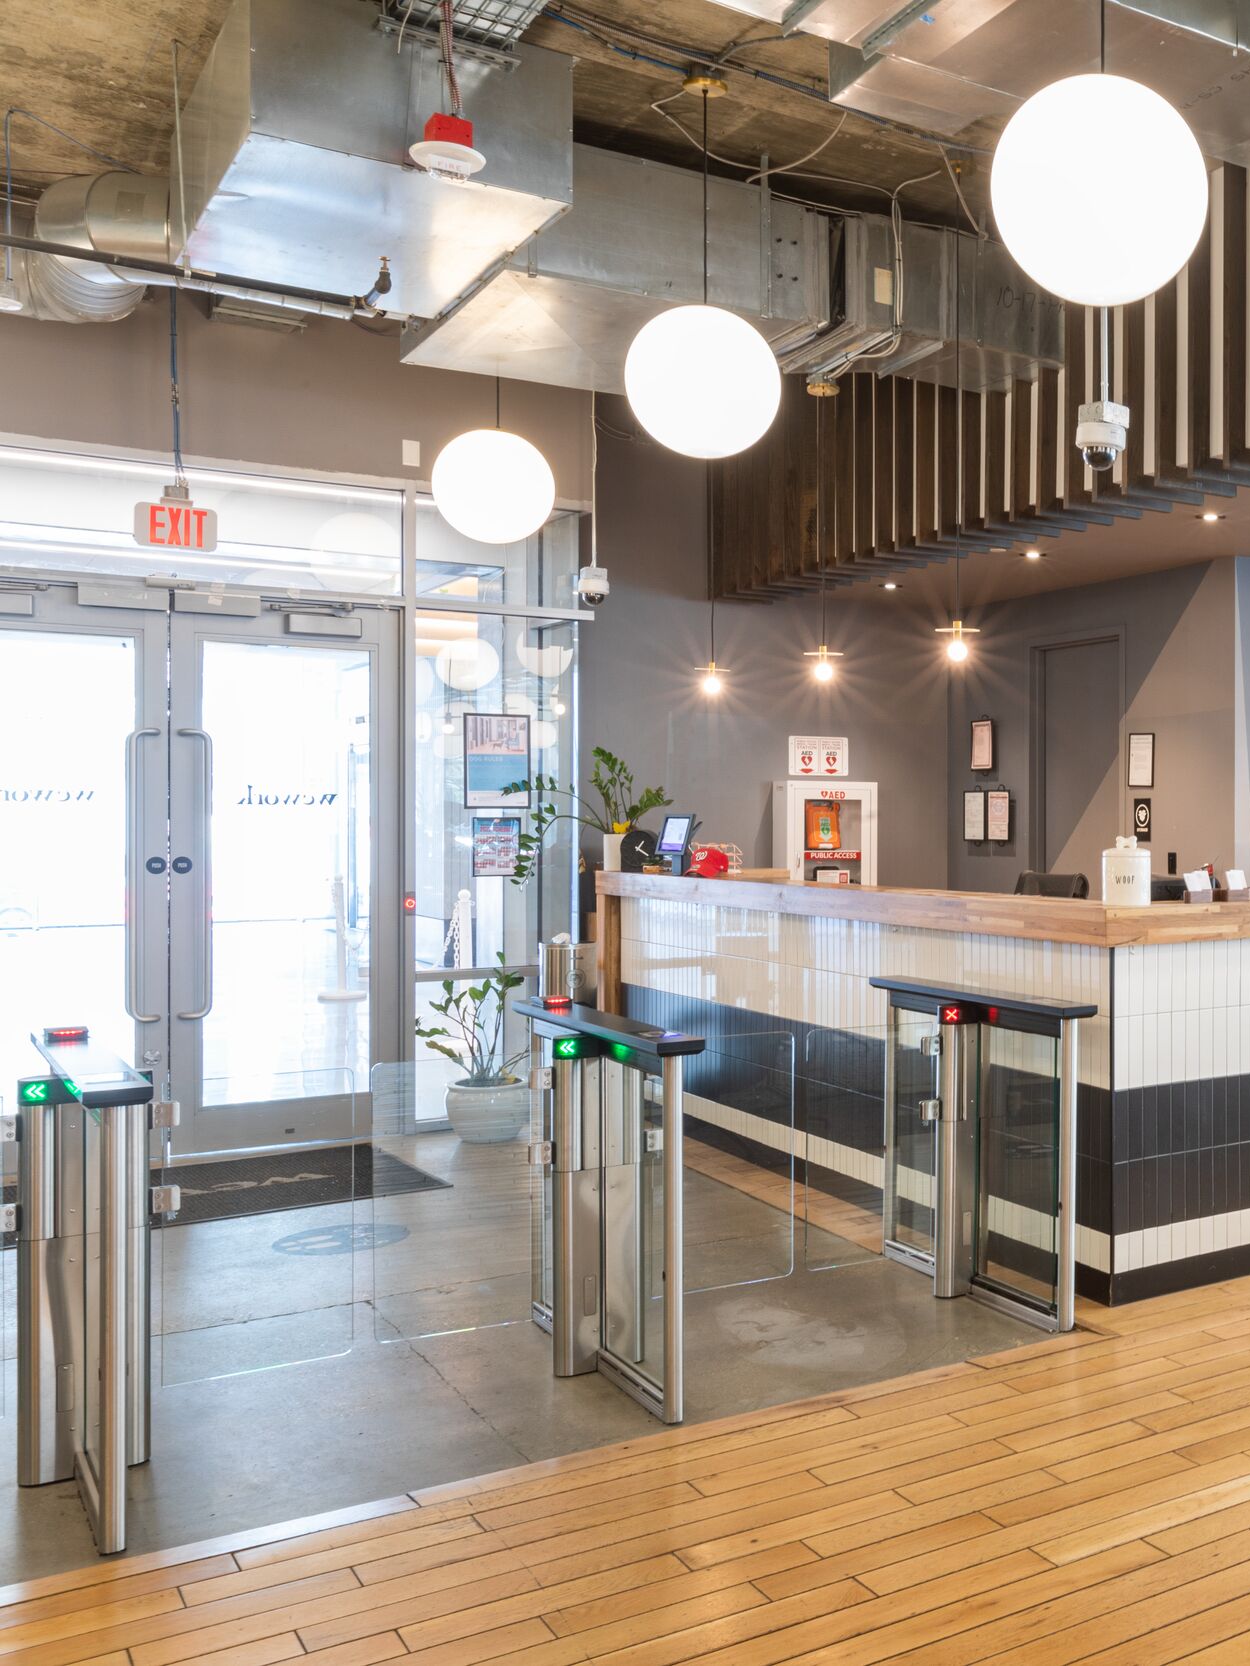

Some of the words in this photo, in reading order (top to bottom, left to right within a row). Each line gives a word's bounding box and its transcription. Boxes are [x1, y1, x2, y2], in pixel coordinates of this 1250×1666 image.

[149, 505, 208, 548] EXIT
[828, 791, 846, 799] AED
[1115, 875, 1135, 885] WOOF
